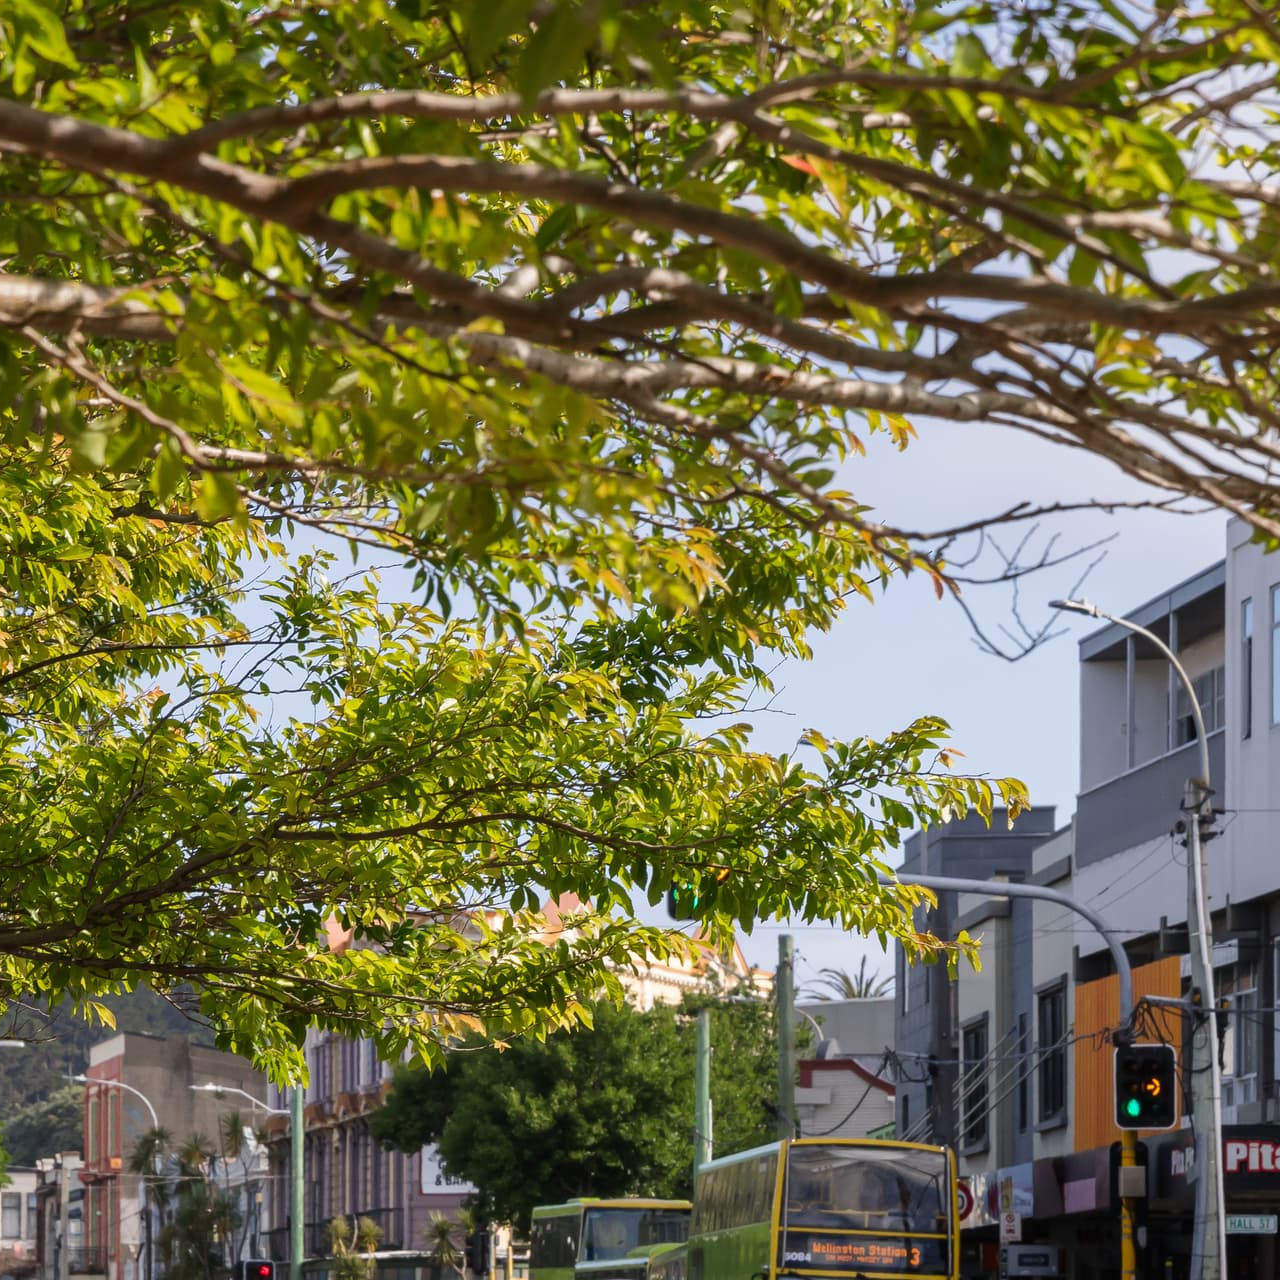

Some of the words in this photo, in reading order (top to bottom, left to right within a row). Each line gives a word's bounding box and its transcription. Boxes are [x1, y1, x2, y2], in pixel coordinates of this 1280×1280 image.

[1229, 1217, 1255, 1229] HALL
[1258, 1217, 1271, 1229] ST
[811, 1241, 866, 1256] Wellington
[868, 1244, 908, 1257] Station
[910, 1247, 920, 1265] 3
